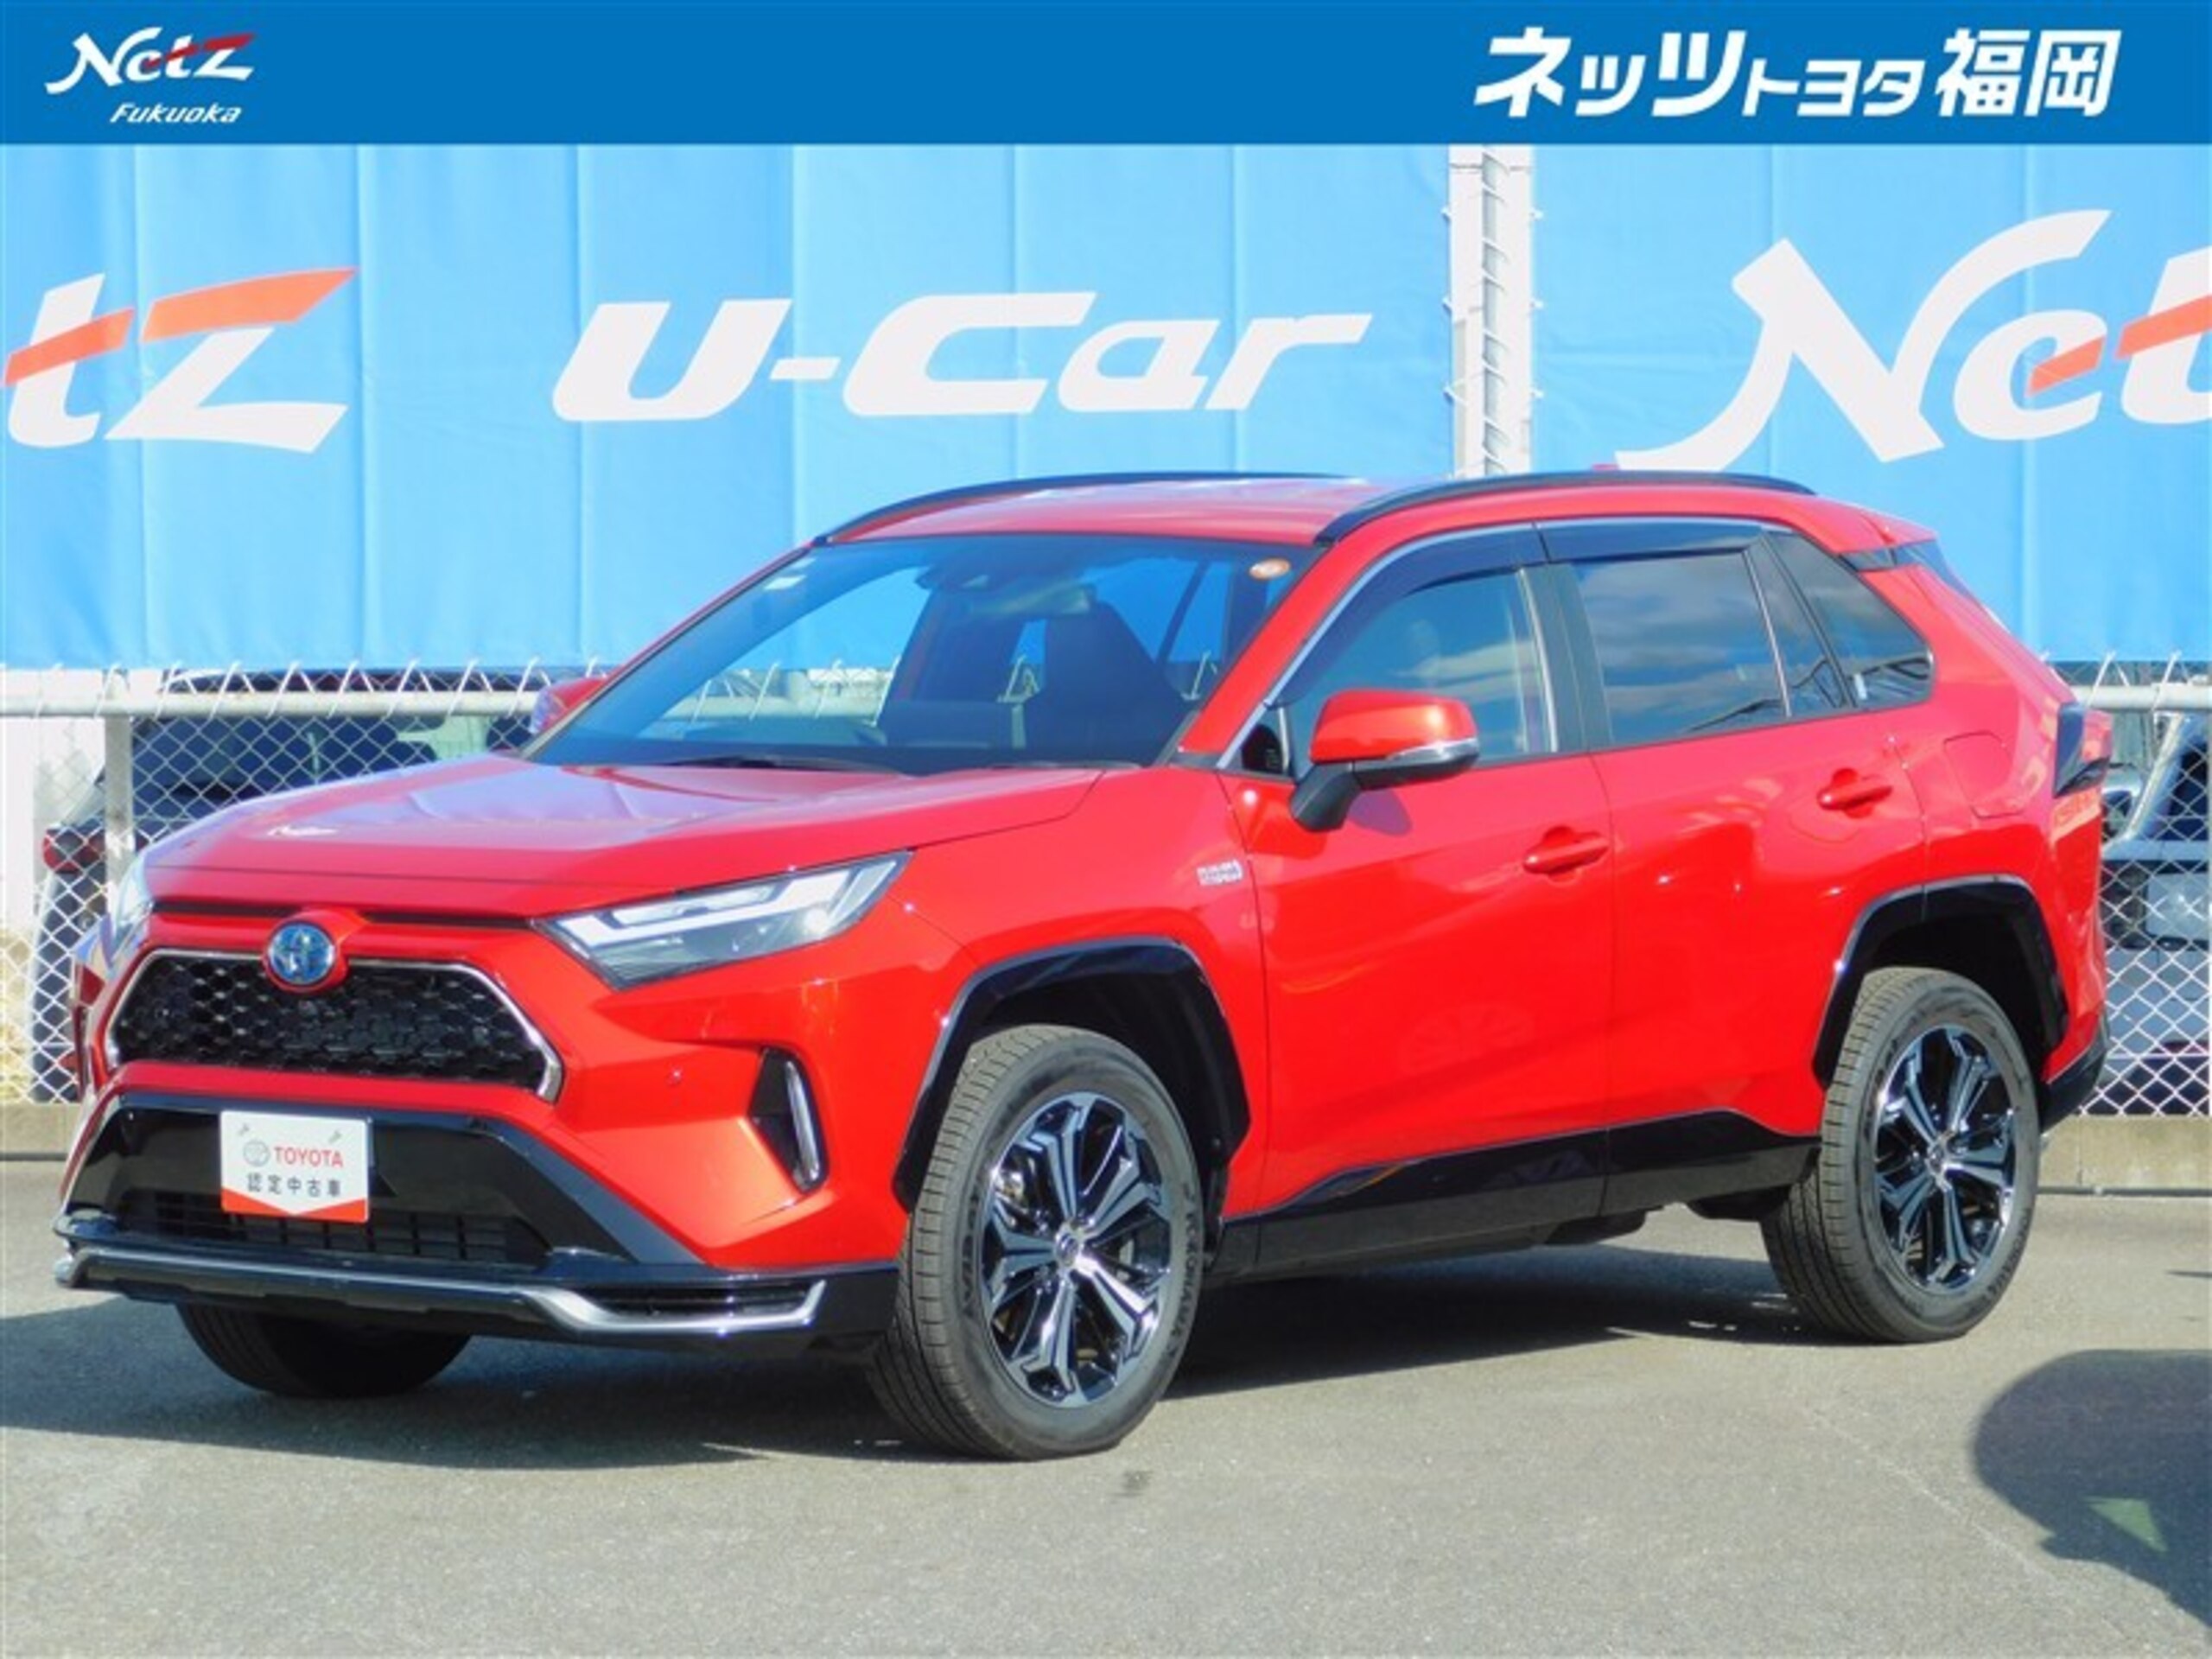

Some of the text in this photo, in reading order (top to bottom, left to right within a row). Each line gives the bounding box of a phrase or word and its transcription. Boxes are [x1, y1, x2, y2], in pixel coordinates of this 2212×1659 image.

[273, 1146, 344, 1168] TOYOTA
[247, 1172, 341, 1198] 認定中古車
